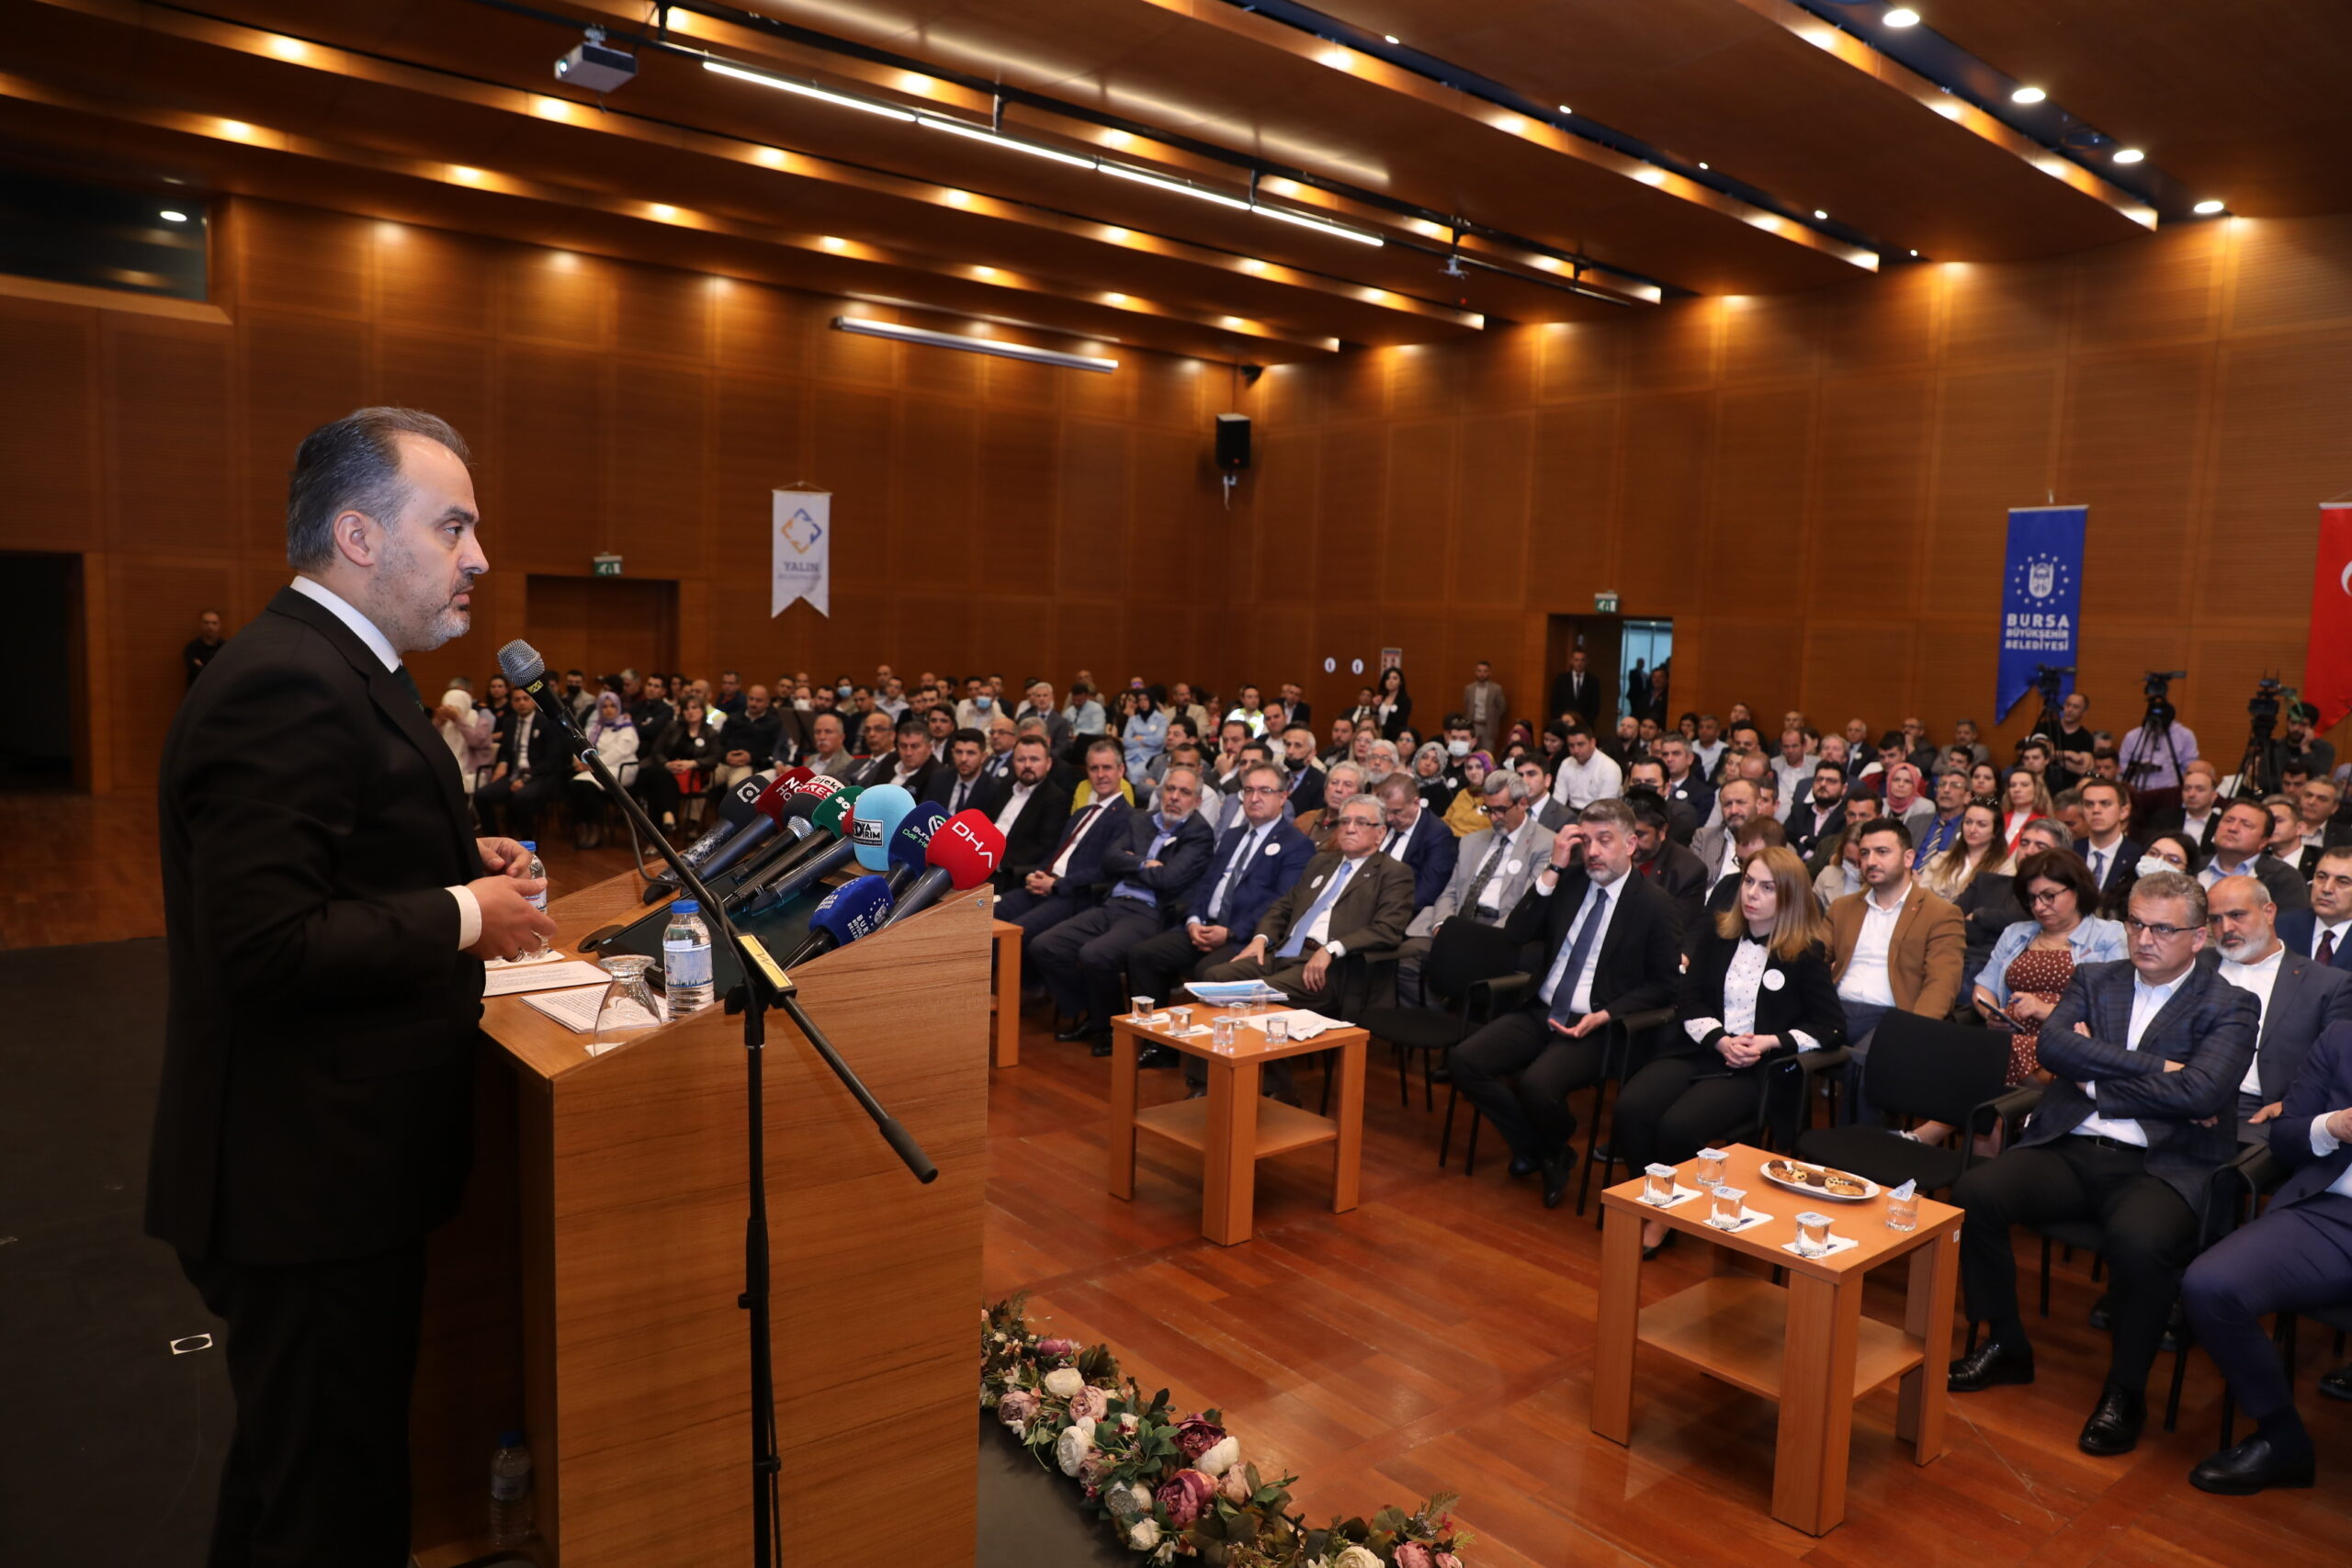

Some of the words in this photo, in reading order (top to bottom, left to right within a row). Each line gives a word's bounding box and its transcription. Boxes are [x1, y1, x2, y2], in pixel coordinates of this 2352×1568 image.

[2007, 613, 2070, 628] BURSA
[2005, 637, 2069, 651] BELEDİYESİ
[856, 914, 869, 934] BUR
